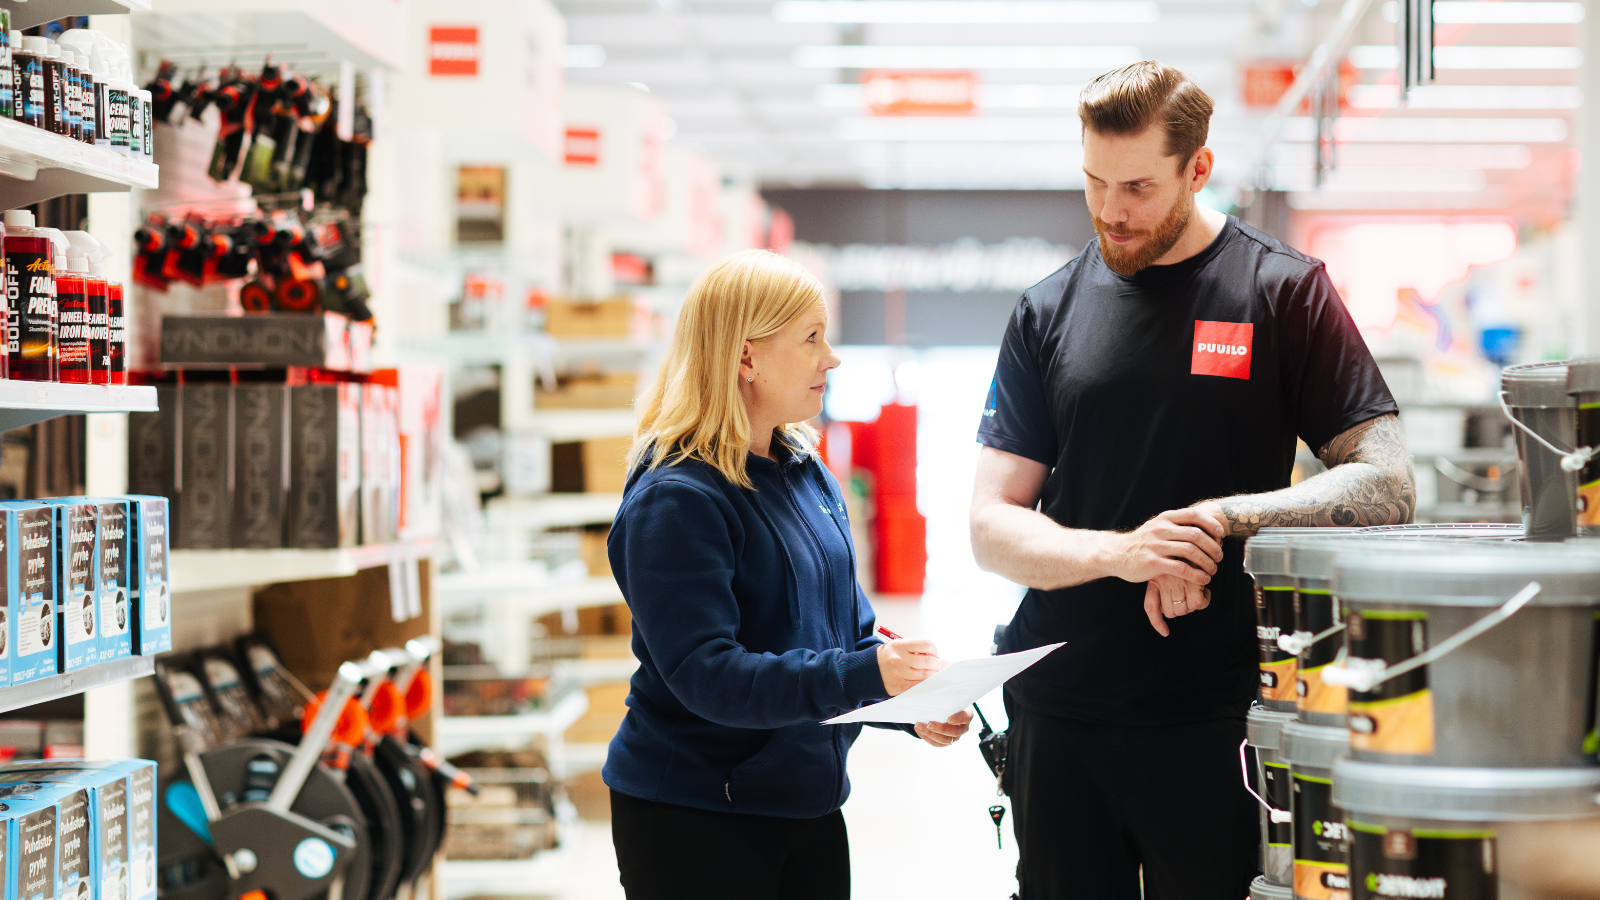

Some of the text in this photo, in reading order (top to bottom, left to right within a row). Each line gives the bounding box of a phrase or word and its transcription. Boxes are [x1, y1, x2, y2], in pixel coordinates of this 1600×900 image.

[13, 63, 23, 117] BOLT-OFF
[52, 69, 61, 121] BOLT-OFF
[7, 263, 20, 353] BOLT-OFF
[60, 311, 82, 323] WHEEL
[60, 324, 81, 338] IRON
[1197, 342, 1248, 356] PUUILO
[24, 833, 53, 856] Puhdistus-
[29, 852, 48, 879] pyyhe
